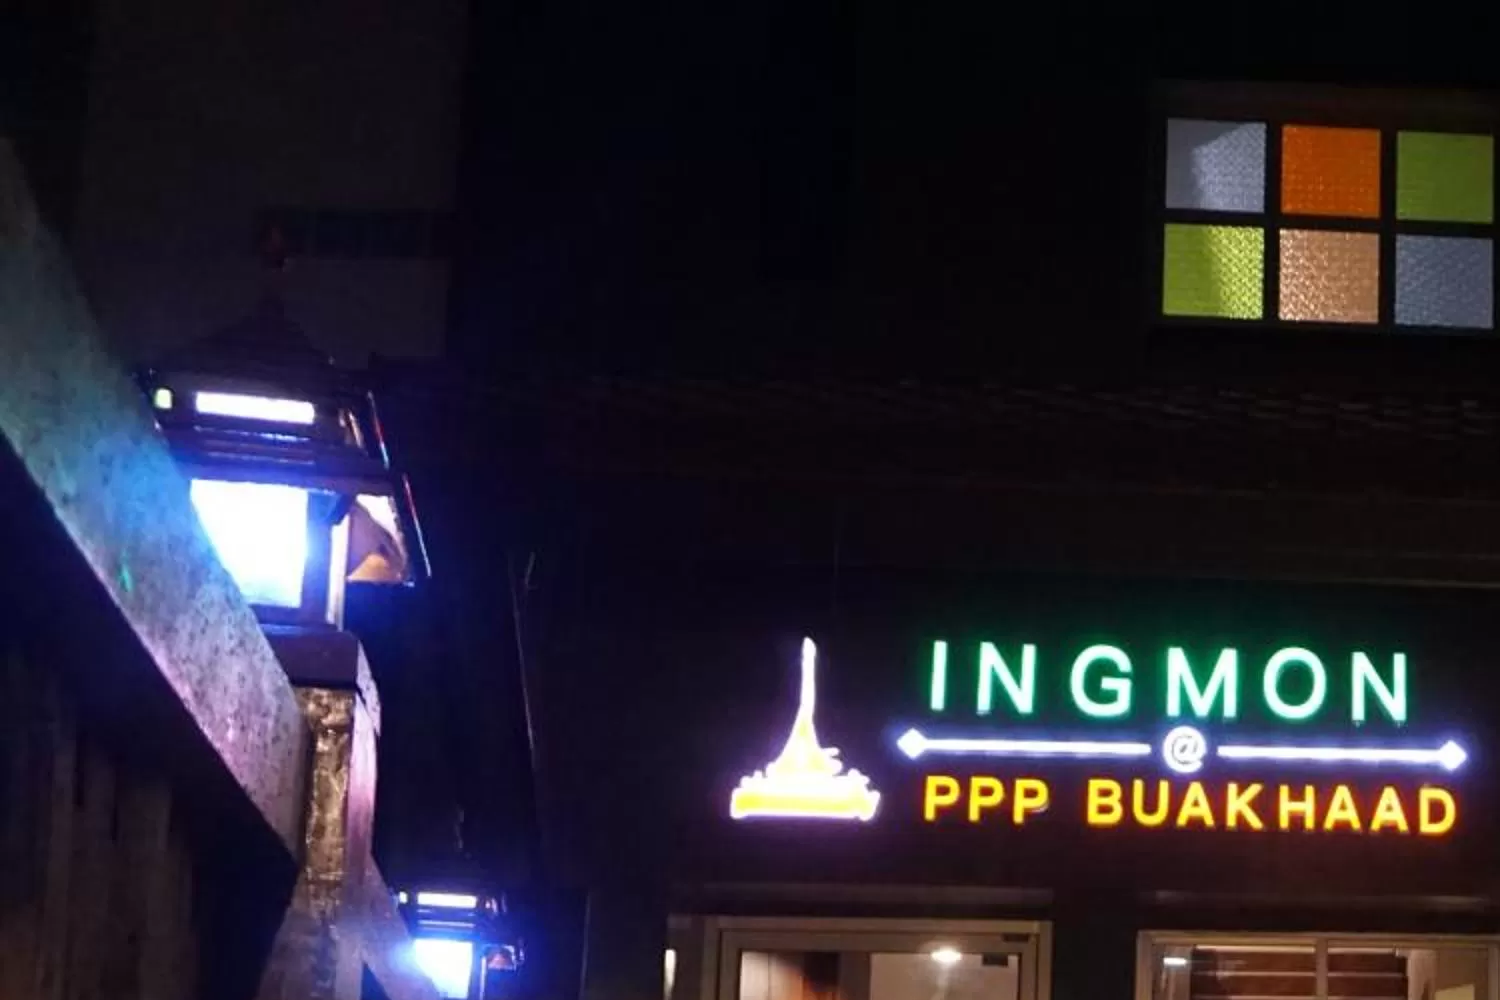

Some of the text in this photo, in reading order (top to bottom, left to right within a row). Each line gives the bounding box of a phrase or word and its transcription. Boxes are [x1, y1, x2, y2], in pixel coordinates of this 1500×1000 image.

[930, 639, 1407, 722] INGMON
[1162, 725, 1206, 774] @
[924, 775, 1456, 834] PPP BUAKHAAD
